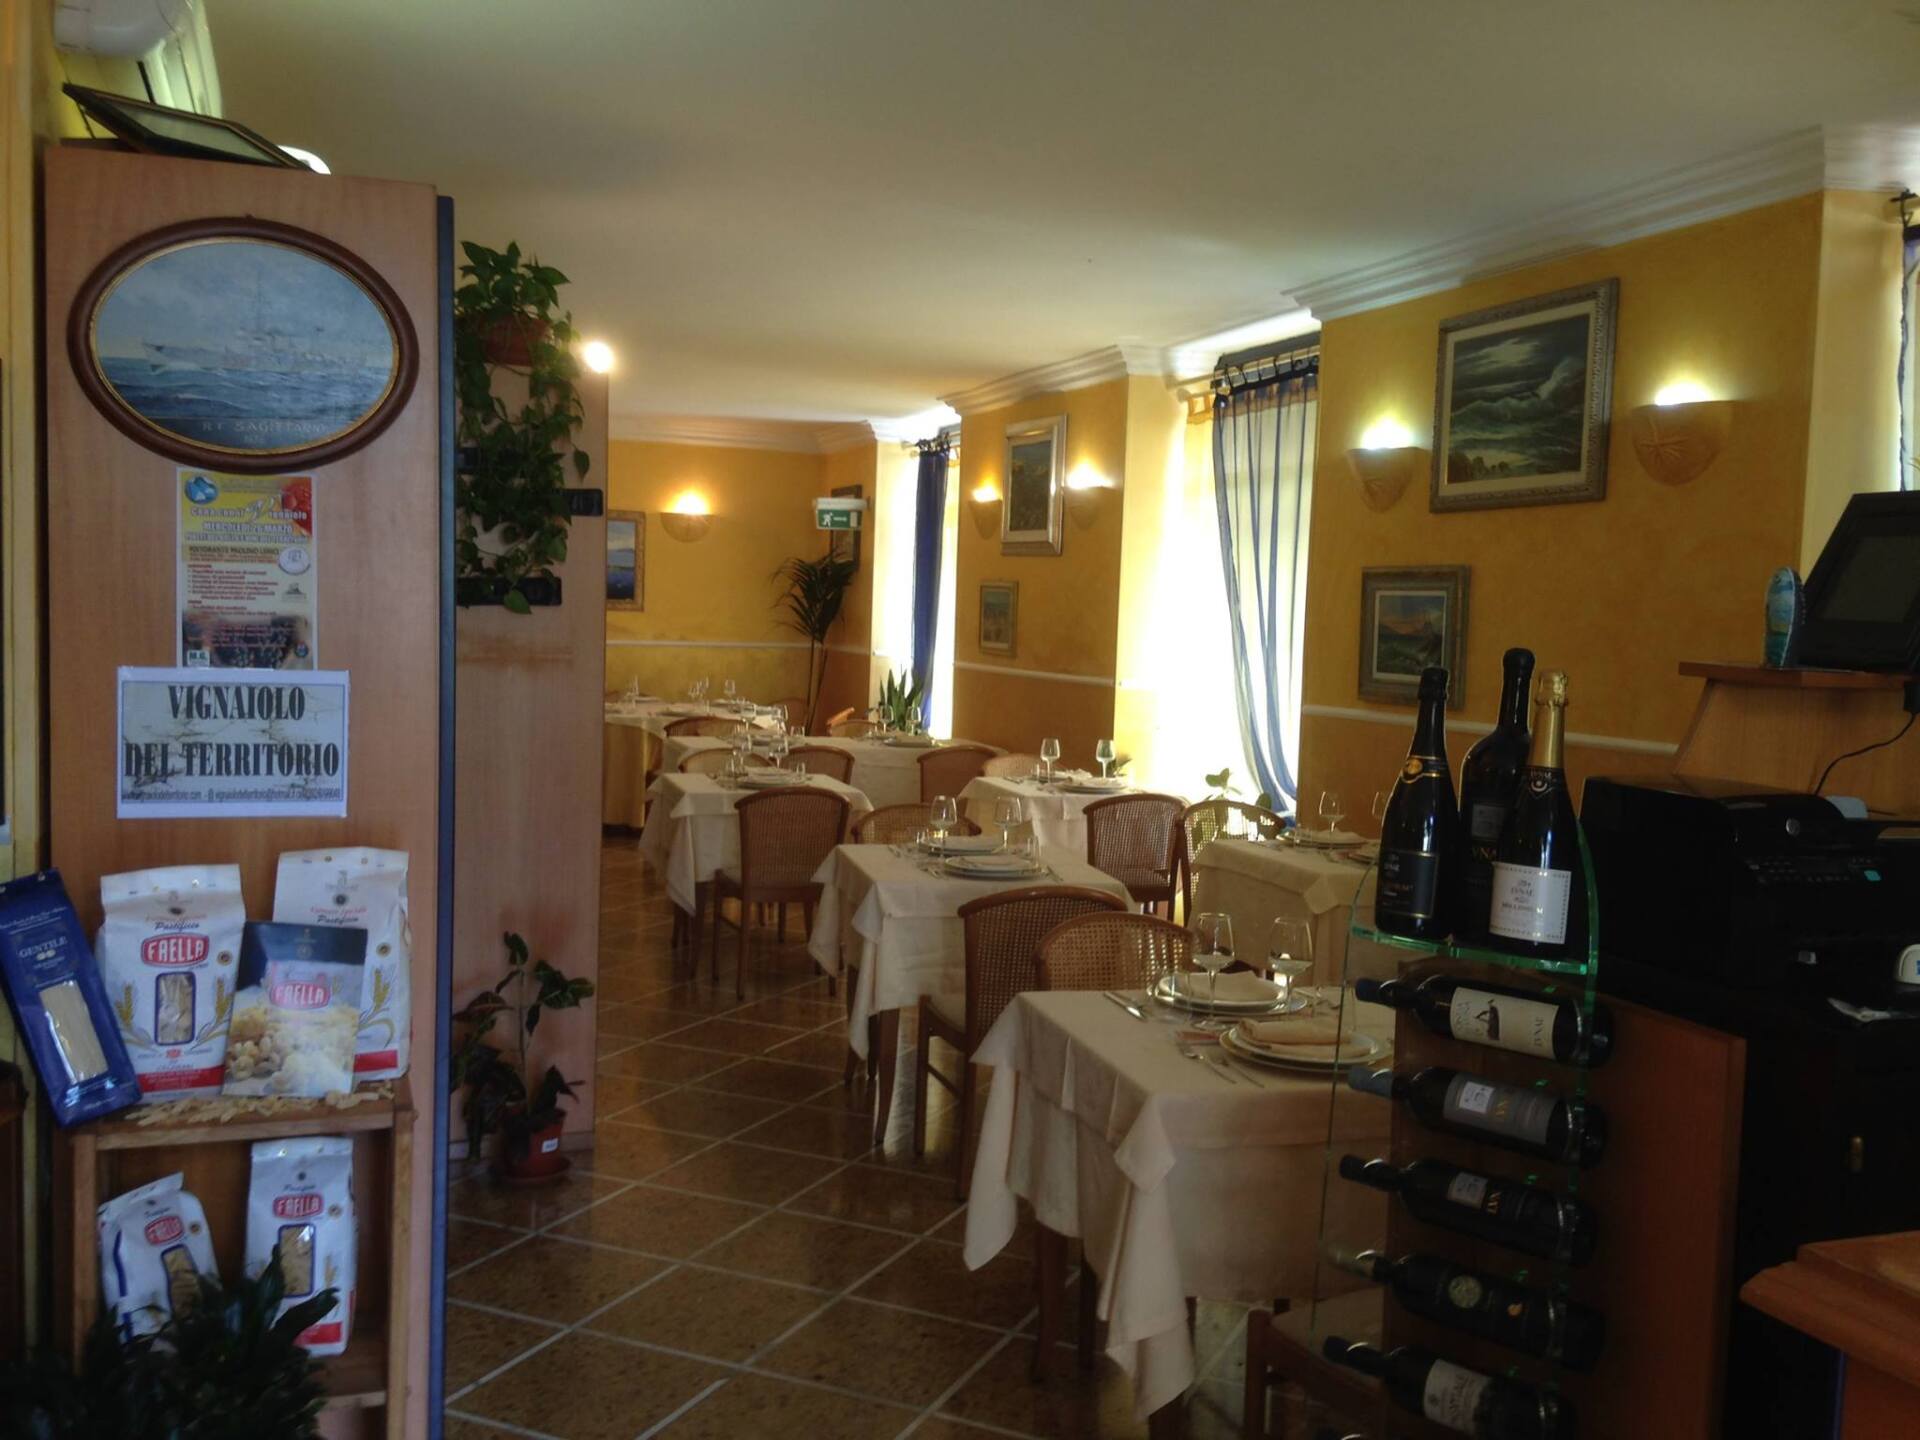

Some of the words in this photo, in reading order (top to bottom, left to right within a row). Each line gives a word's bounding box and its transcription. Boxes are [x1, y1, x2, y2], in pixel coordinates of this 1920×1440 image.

[168, 685, 305, 721] VIGNAIOLO
[124, 742, 170, 778] DEL
[180, 742, 339, 777] TERRITORIO
[148, 937, 204, 962] FAELLA
[275, 983, 325, 1005] FAELLA
[278, 1196, 320, 1216] FAELLA
